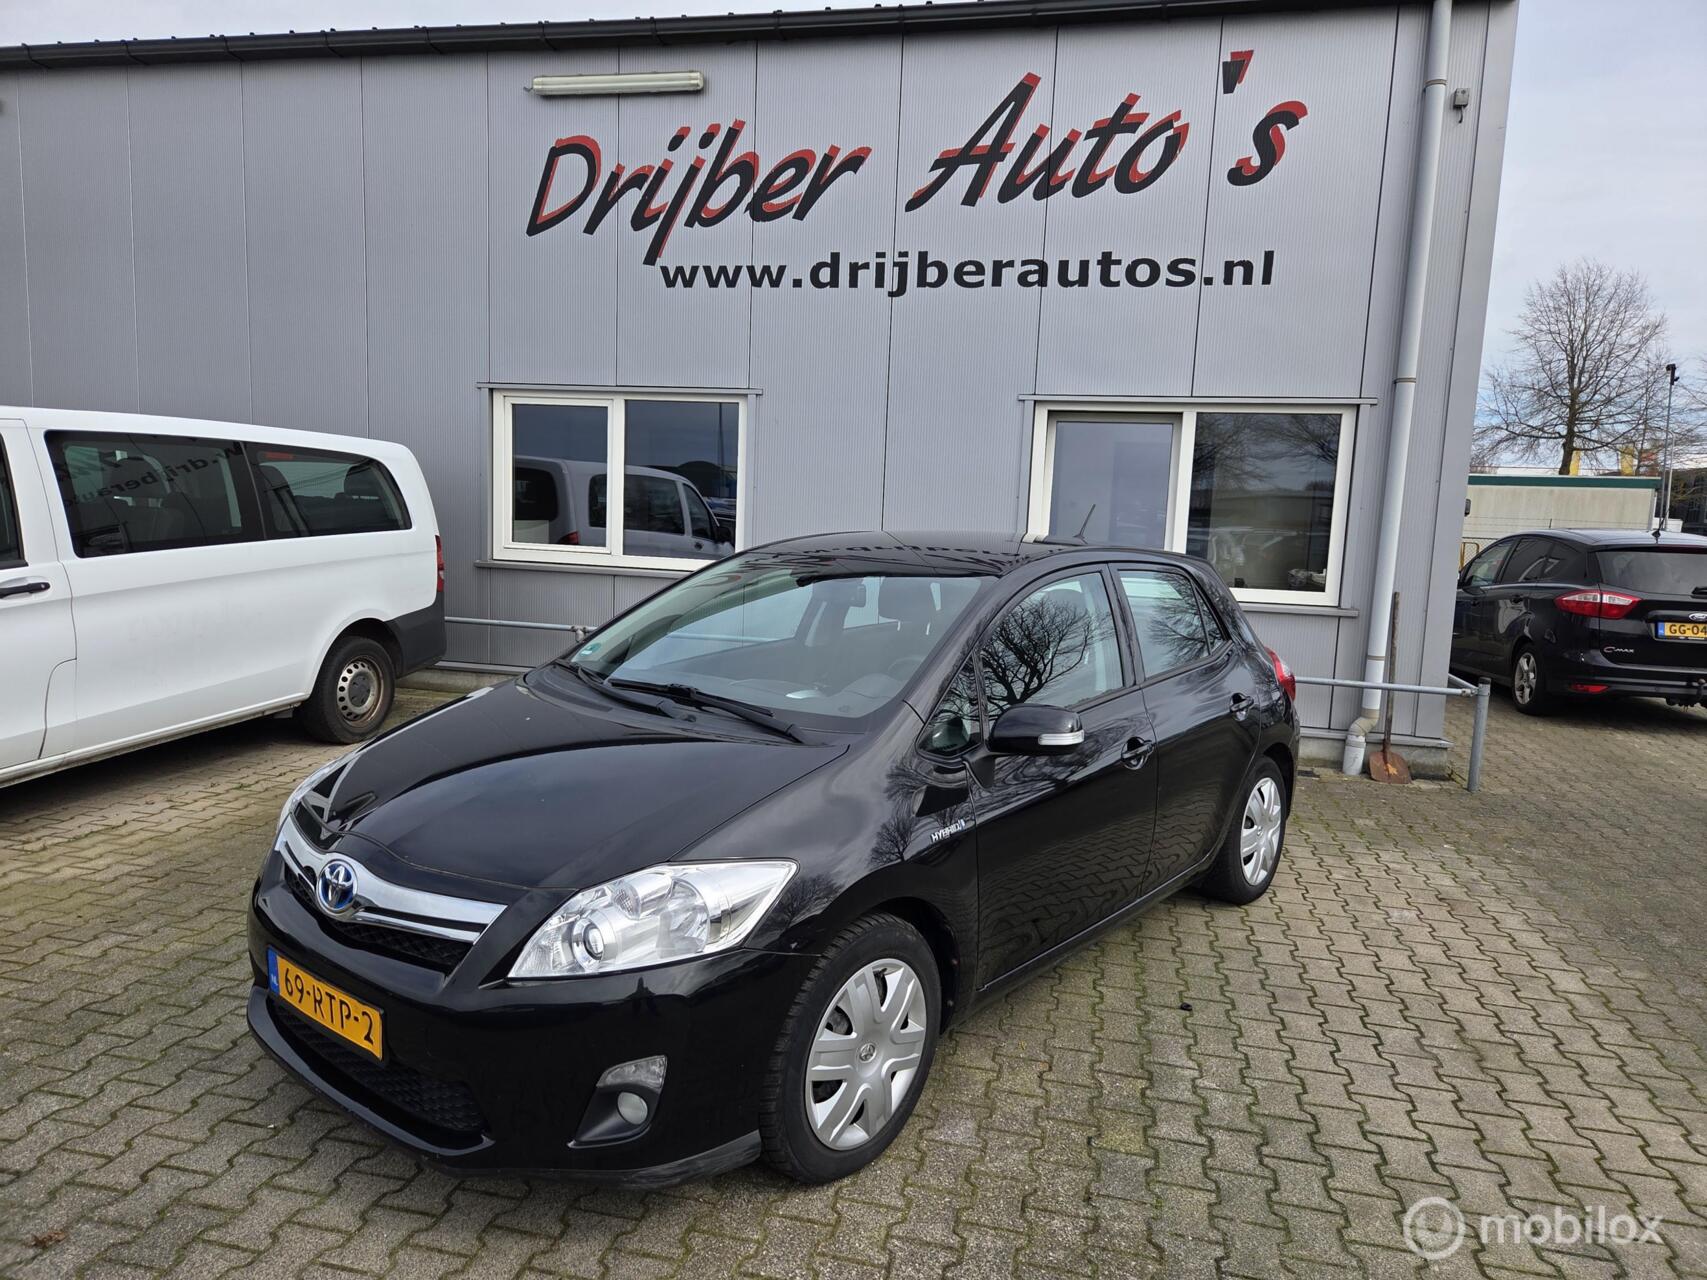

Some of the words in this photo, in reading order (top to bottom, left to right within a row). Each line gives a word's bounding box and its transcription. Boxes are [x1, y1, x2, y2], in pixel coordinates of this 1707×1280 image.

[526, 118, 873, 266] Drijber
[905, 50, 1308, 213] Auto's
[660, 250, 1275, 298] www.drijberautos.nl
[931, 819, 963, 842] HYBRID
[284, 967, 374, 1045] 69-RTP-2
